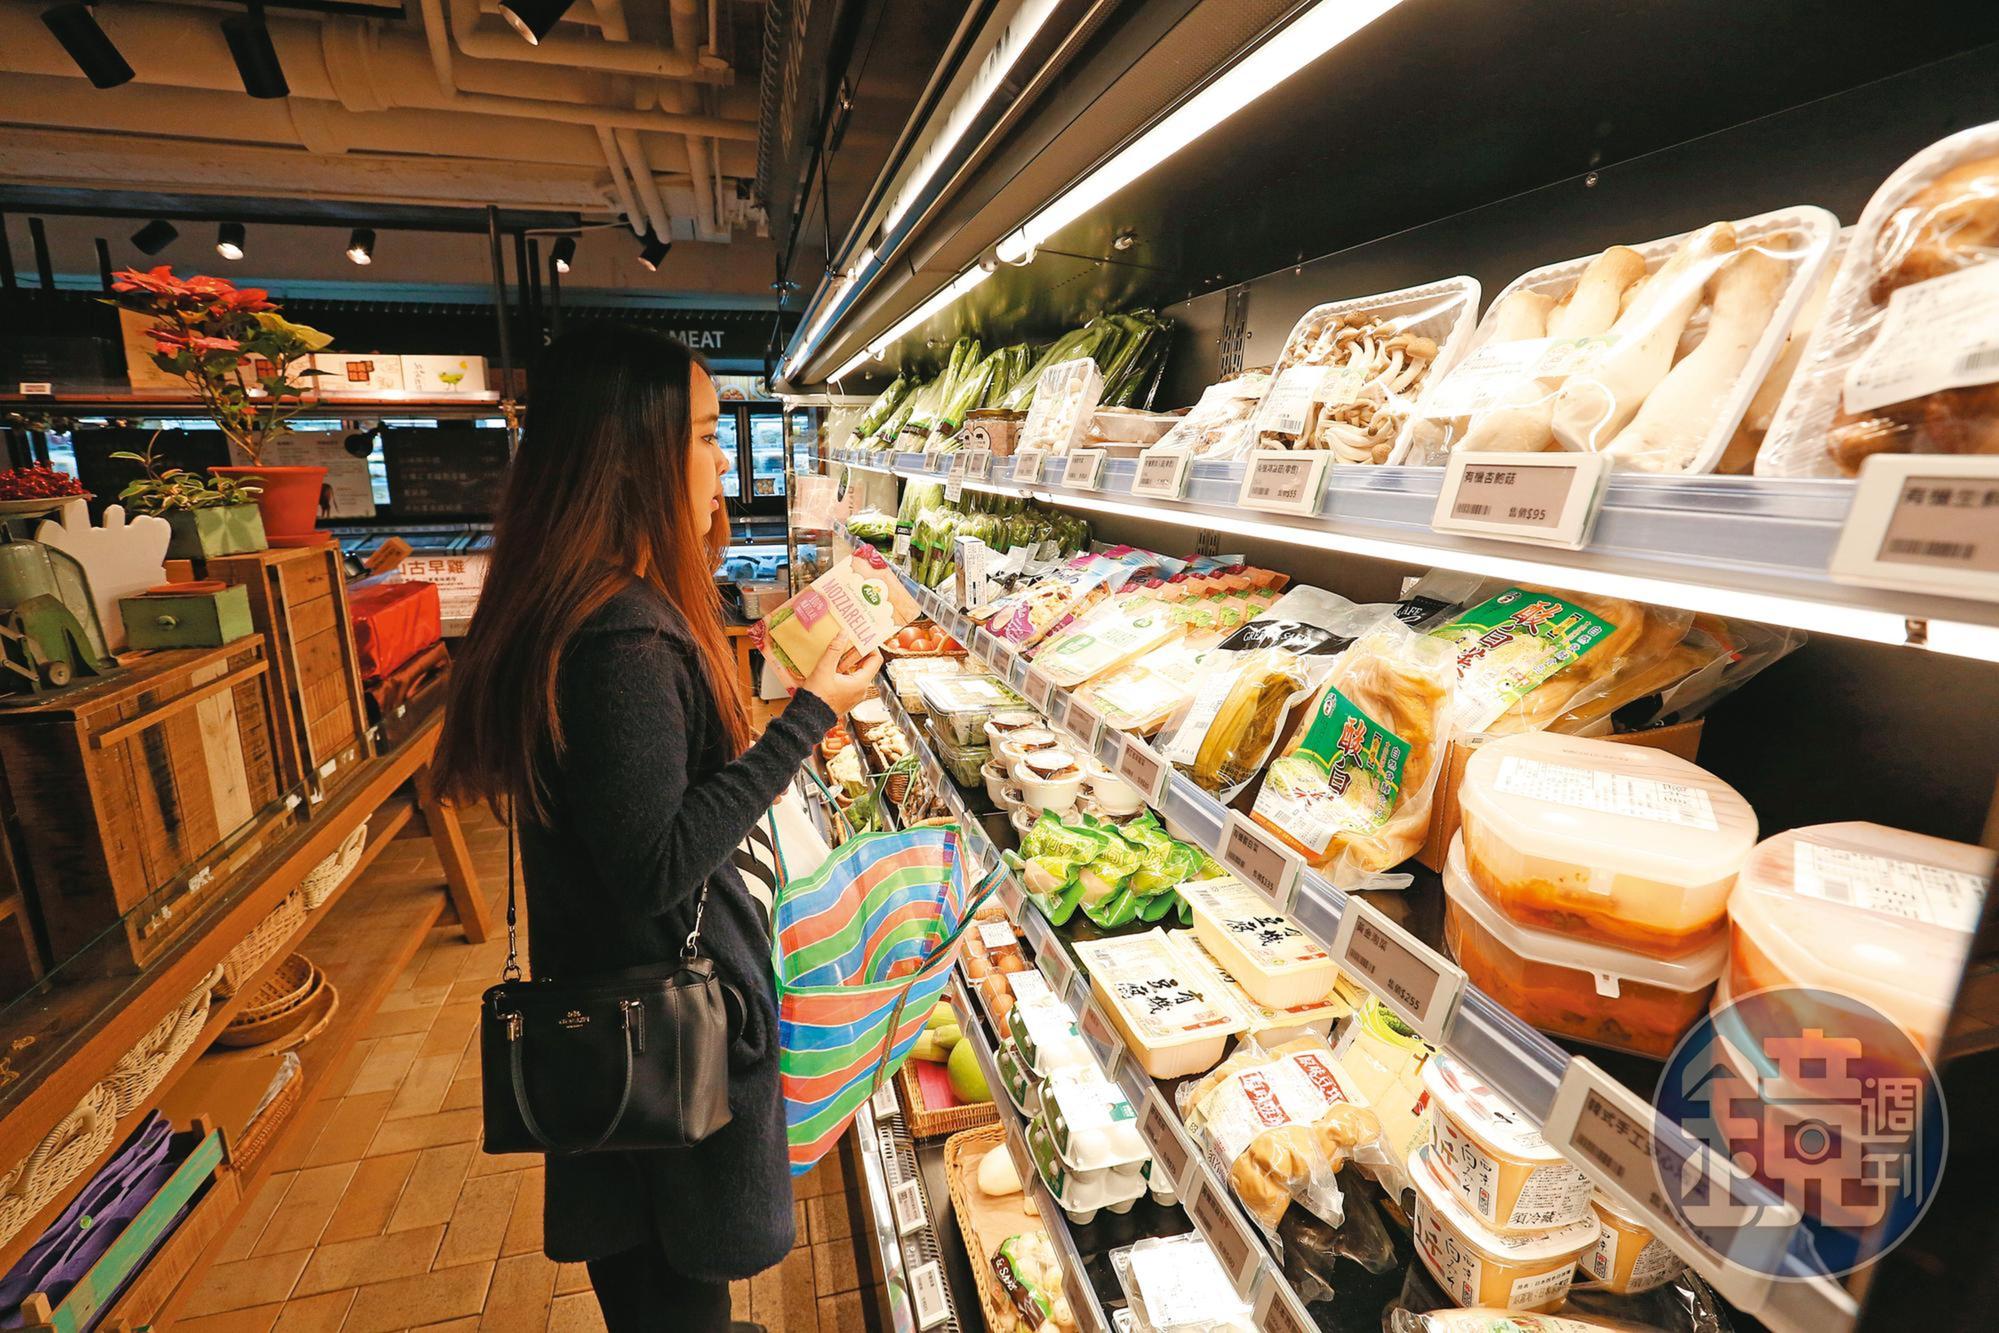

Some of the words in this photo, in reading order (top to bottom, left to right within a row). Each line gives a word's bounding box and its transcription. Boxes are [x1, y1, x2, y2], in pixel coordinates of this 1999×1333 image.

[668, 330, 725, 349] MEAT
[1464, 471, 1517, 486] 有機杏鮑菇
[822, 578, 876, 646] MOZZARELLA
